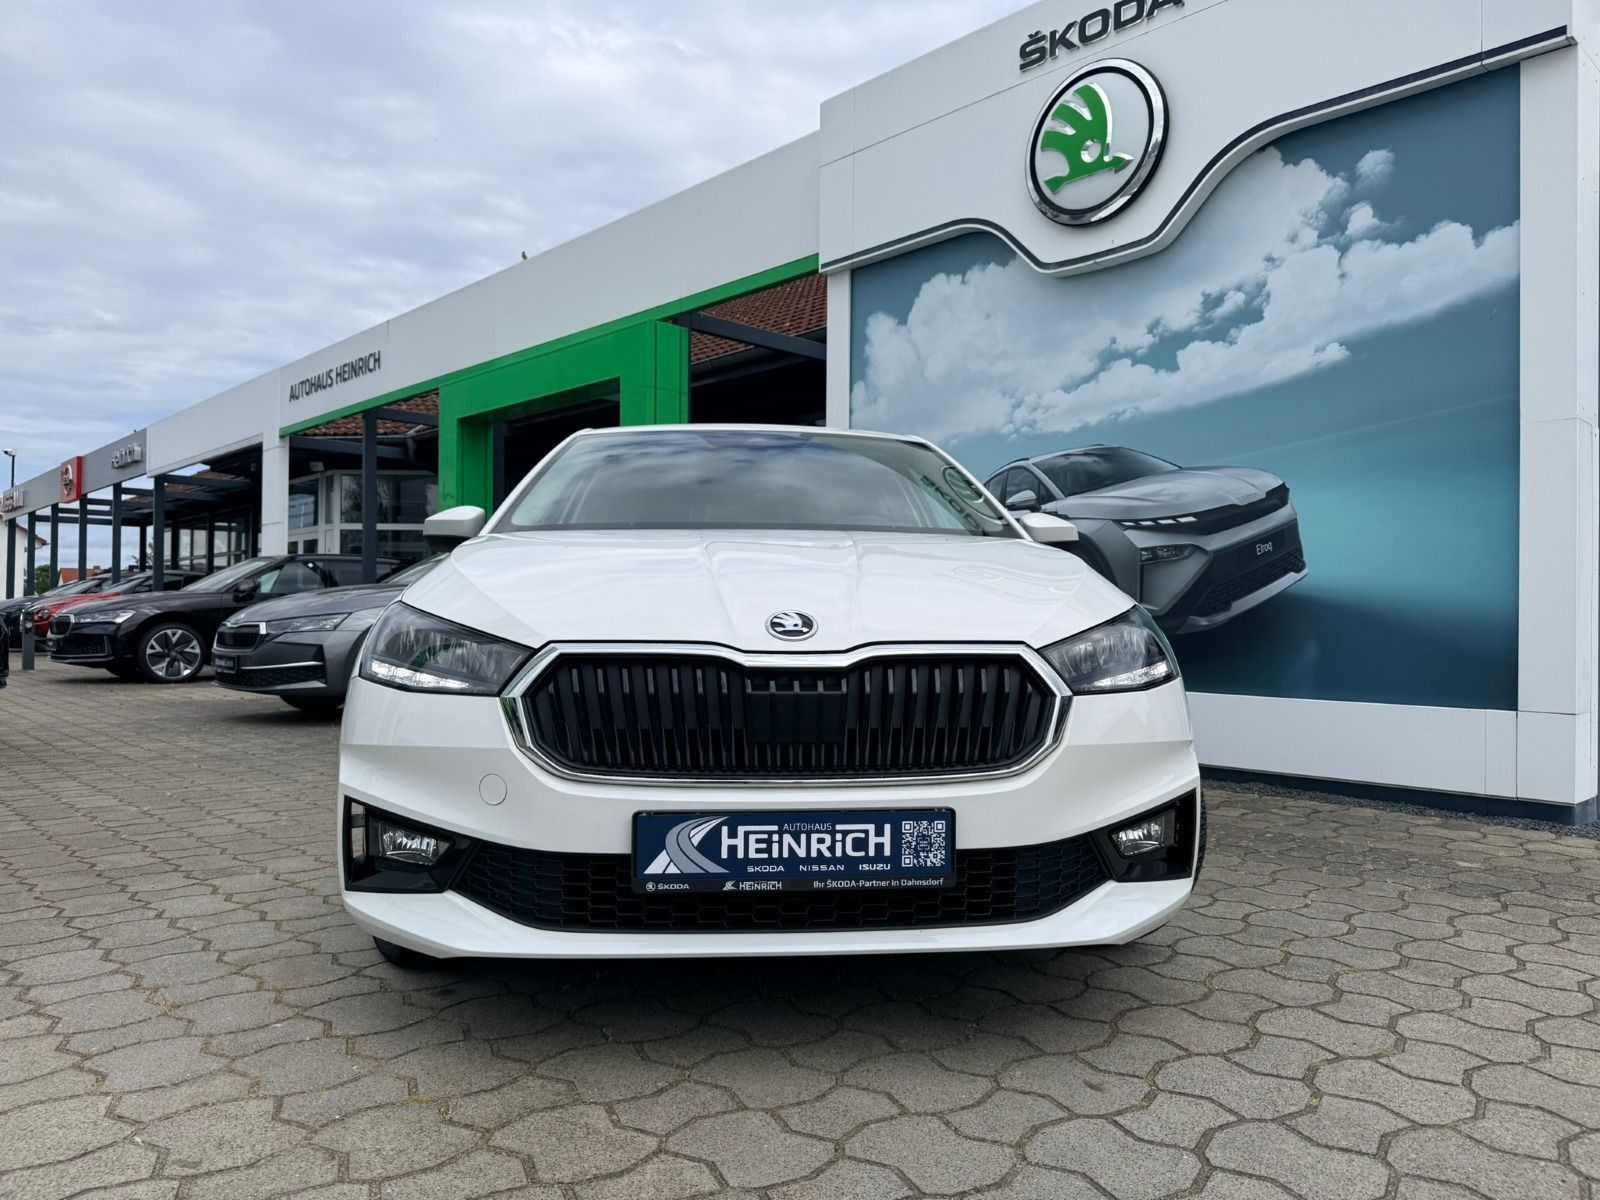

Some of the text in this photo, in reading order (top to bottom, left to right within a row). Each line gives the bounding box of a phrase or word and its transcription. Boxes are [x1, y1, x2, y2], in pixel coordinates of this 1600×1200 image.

[289, 350, 381, 402] AUTOHAUS HEINRICH
[783, 822, 832, 831] AUTOHAUS
[799, 864, 845, 872] NISSAN
[858, 863, 891, 871] ISUZU
[813, 880, 825, 888] Ihr
[826, 879, 890, 888] ŠKODA-Partner
[901, 877, 944, 887] Dahnsdorf
